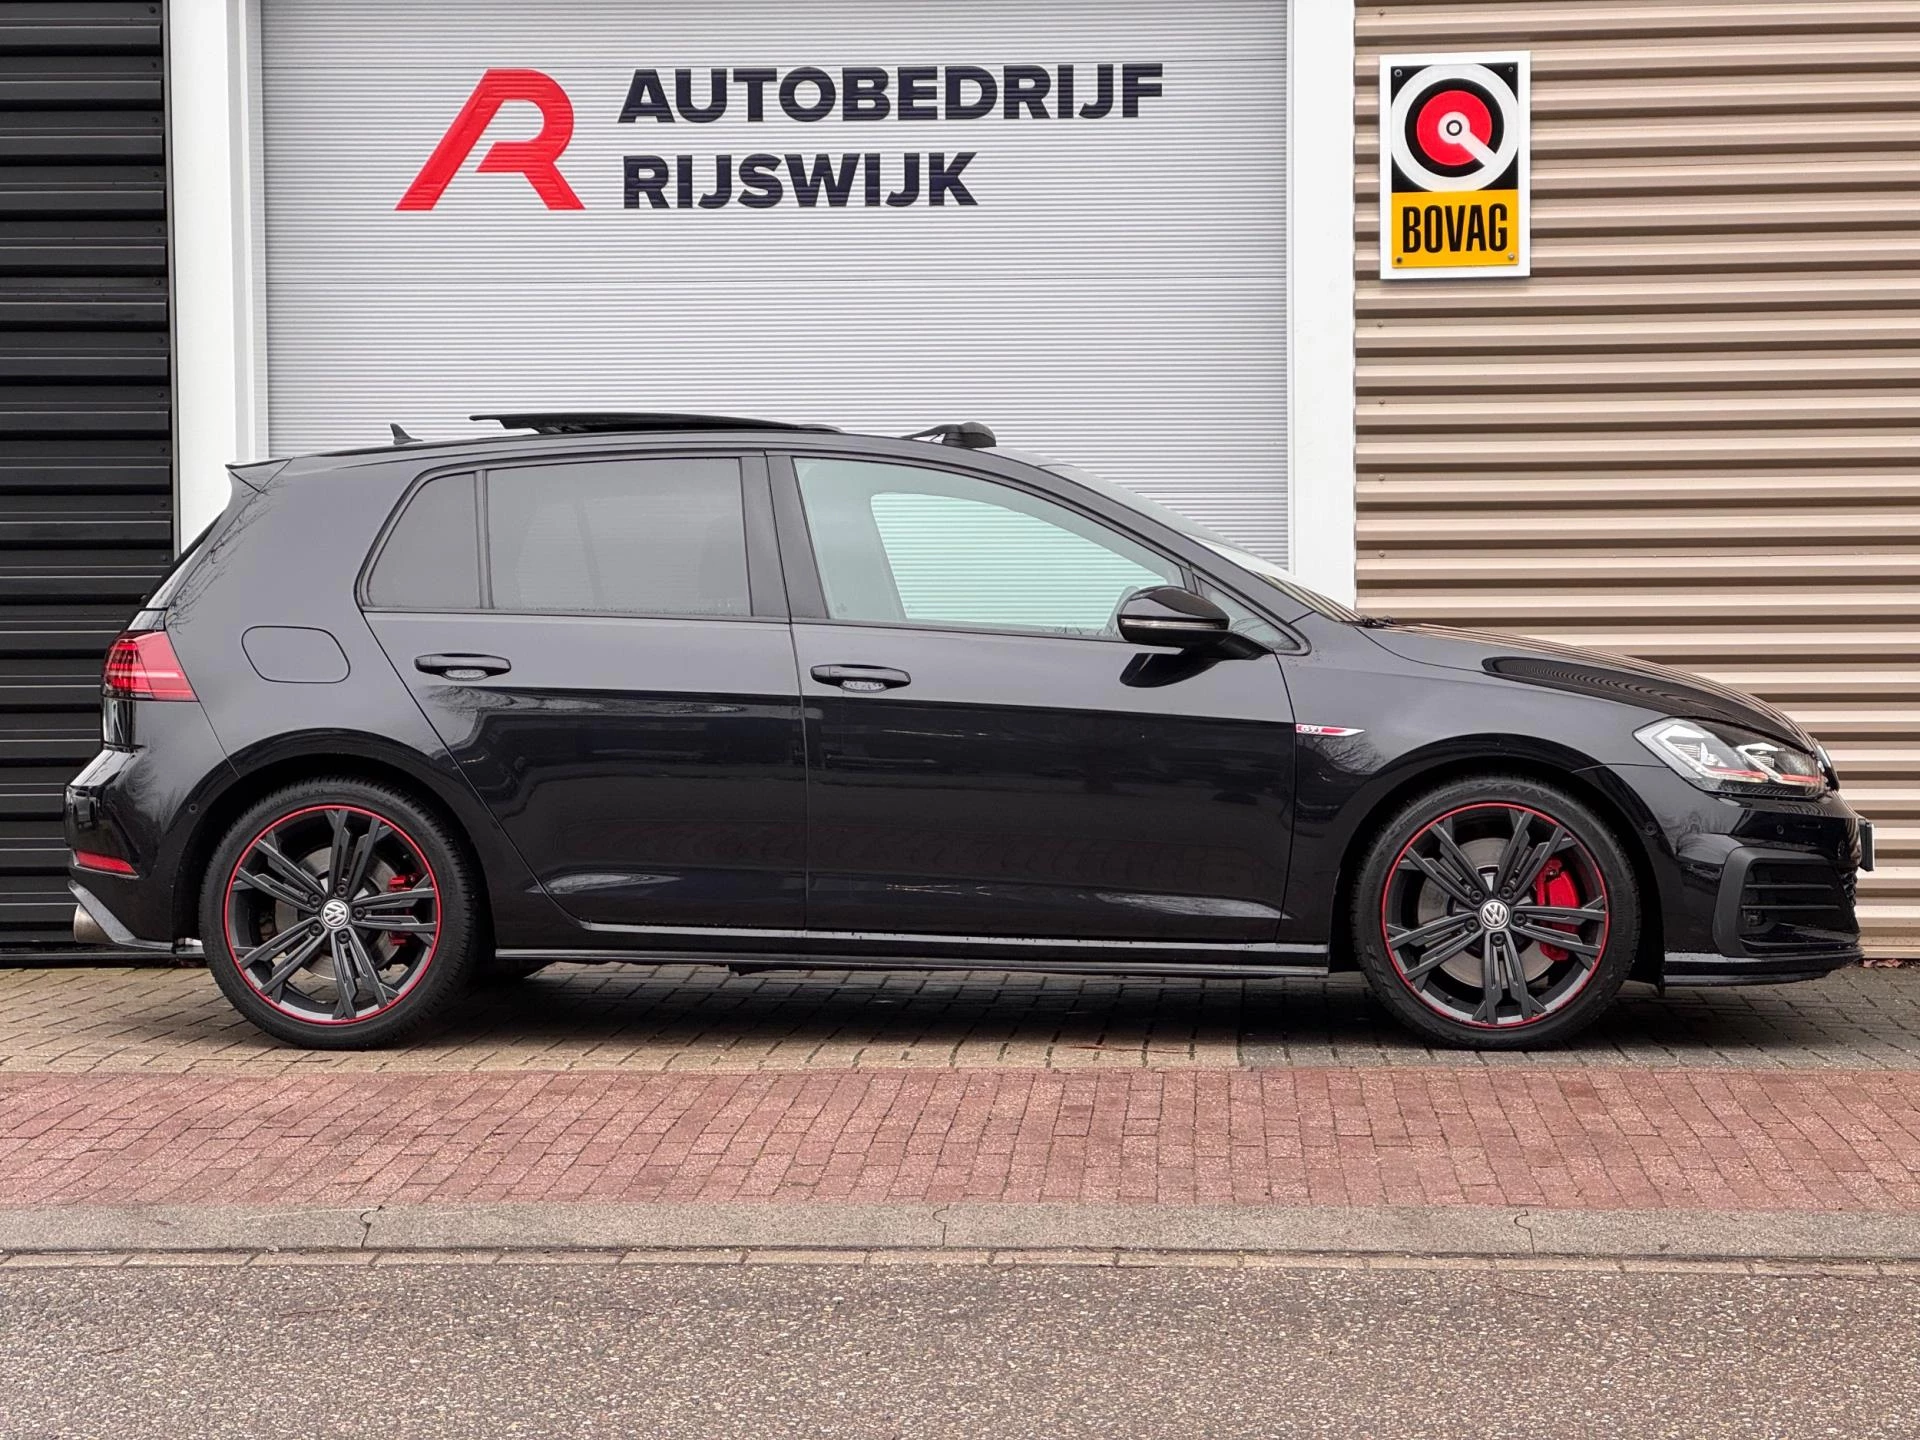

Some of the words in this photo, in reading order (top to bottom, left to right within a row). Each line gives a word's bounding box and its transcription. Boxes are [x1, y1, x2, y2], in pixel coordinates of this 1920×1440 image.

[618, 63, 1163, 123] AUTOBEDRIJF
[623, 151, 978, 209] RIJSWIJK
[1403, 203, 1507, 254] BOVAG
